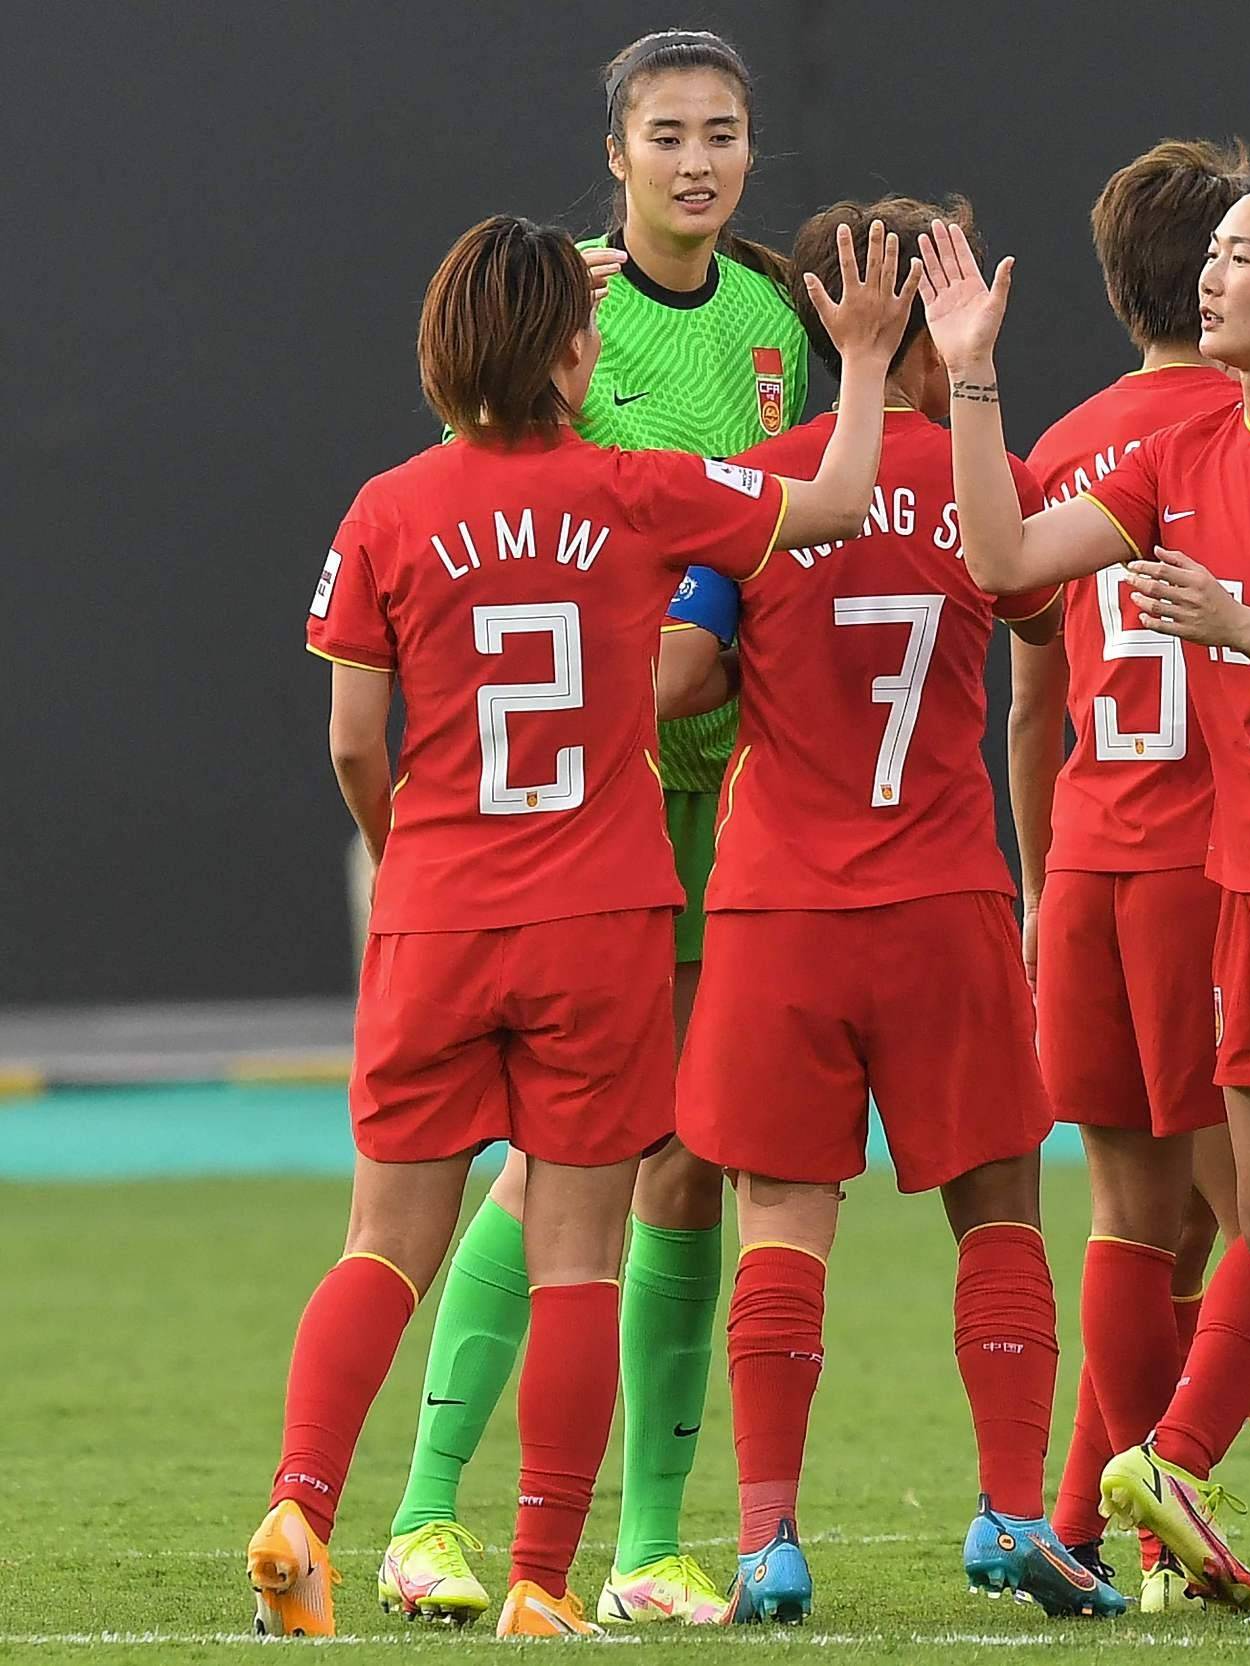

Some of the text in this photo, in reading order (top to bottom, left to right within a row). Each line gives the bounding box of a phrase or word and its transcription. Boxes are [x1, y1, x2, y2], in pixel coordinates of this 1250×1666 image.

[759, 382, 780, 394] CFA
[430, 521, 481, 580] LI
[472, 601, 585, 815] 2
[833, 594, 946, 807] 7
[1094, 563, 1187, 761] 5
[284, 1473, 329, 1493] CFA
